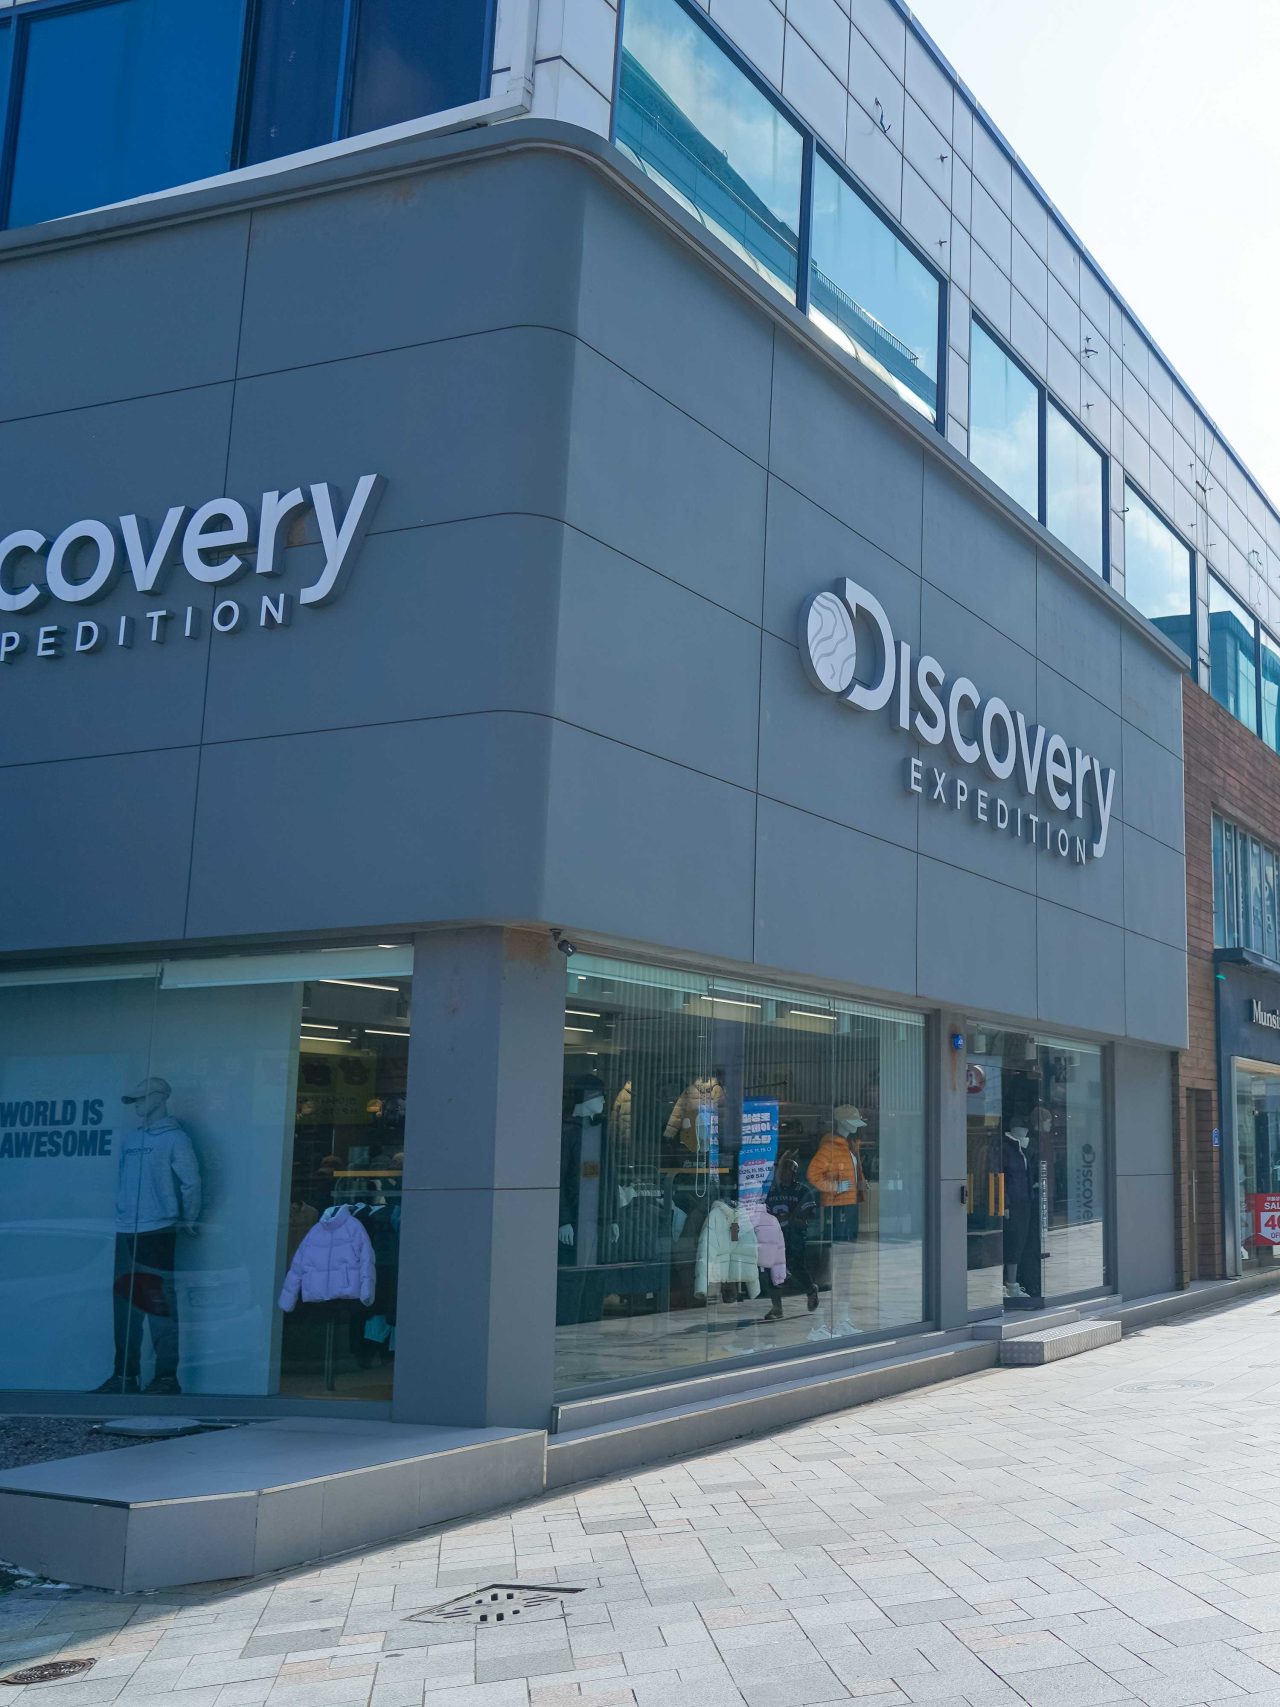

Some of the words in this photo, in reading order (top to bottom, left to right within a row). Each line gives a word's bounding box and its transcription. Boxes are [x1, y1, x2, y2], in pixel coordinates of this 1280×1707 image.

[806, 577, 1116, 859] Discovery
[908, 757, 1087, 866] EXPEDITION
[0, 1100, 77, 1128] WORLD
[81, 1098, 105, 1126] IS
[0, 1129, 113, 1159] AWESOME
